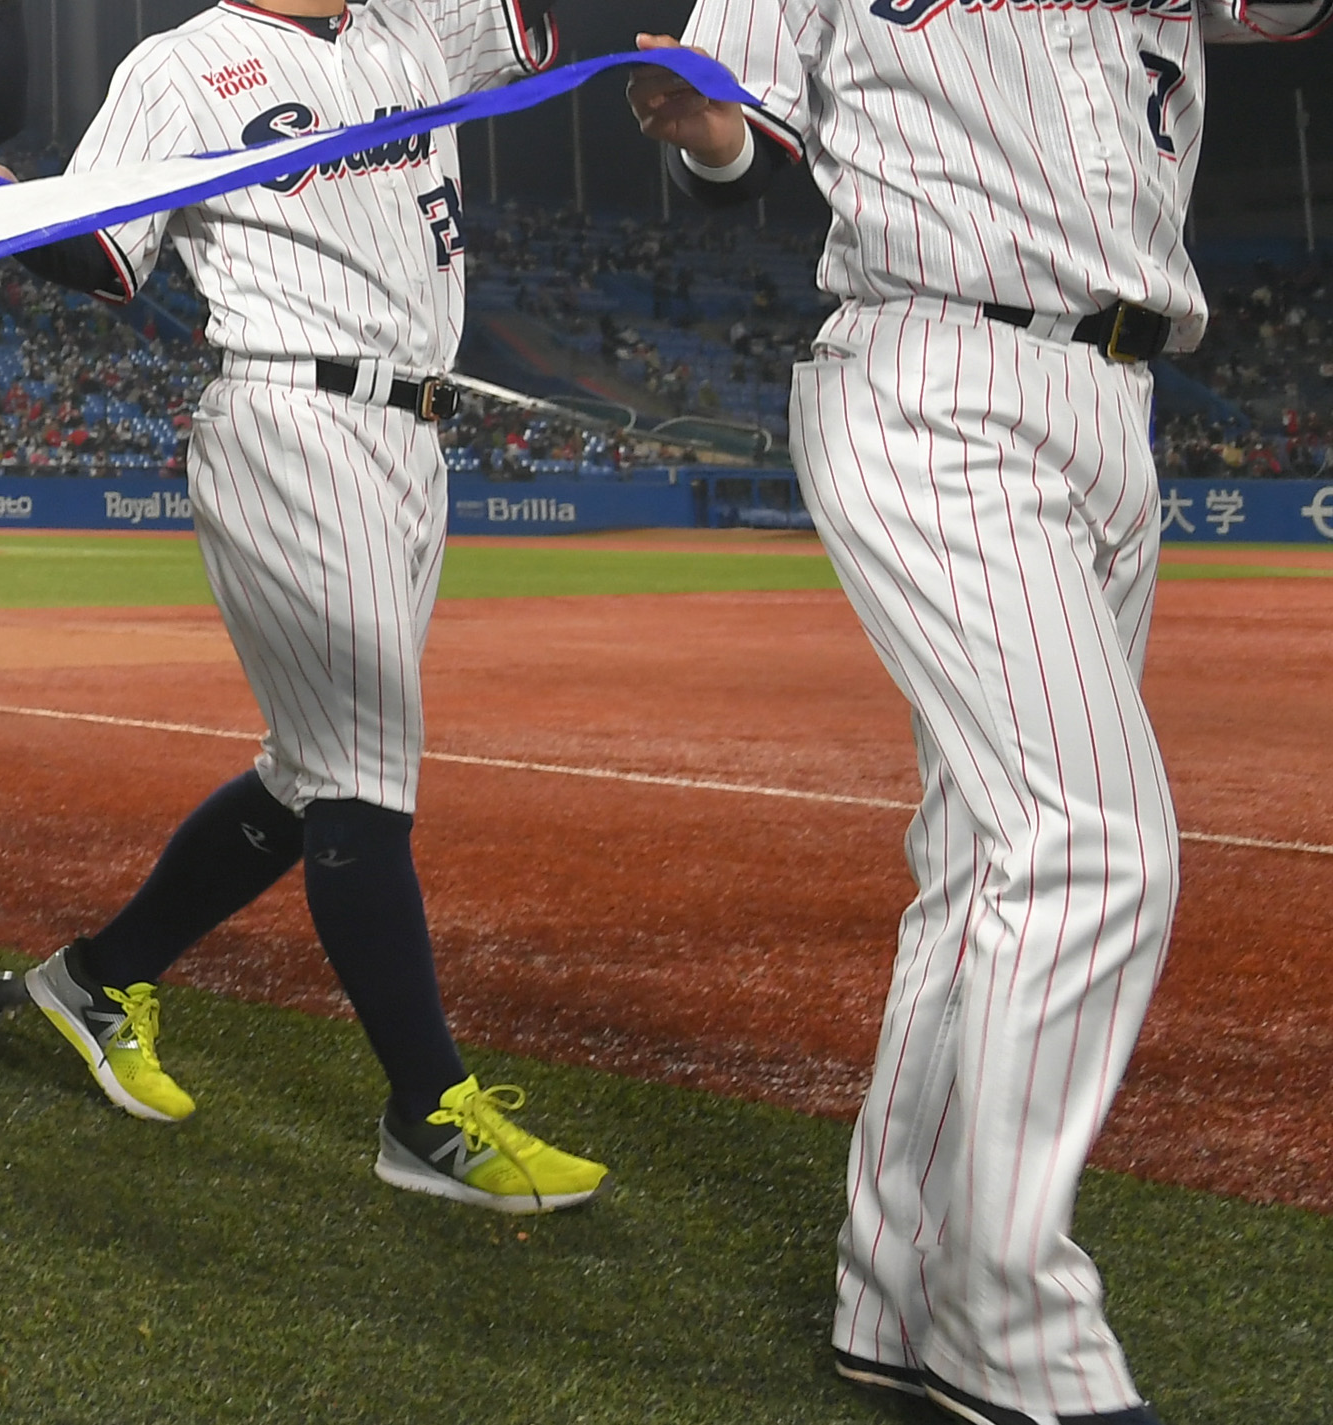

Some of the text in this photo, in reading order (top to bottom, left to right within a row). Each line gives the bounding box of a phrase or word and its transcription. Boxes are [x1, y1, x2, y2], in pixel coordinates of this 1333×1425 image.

[201, 57, 264, 87] Yakult
[213, 71, 268, 99] 1000
[1138, 50, 1186, 162] 7
[104, 491, 193, 524] Royal Ho
[487, 497, 576, 522] Brillia
